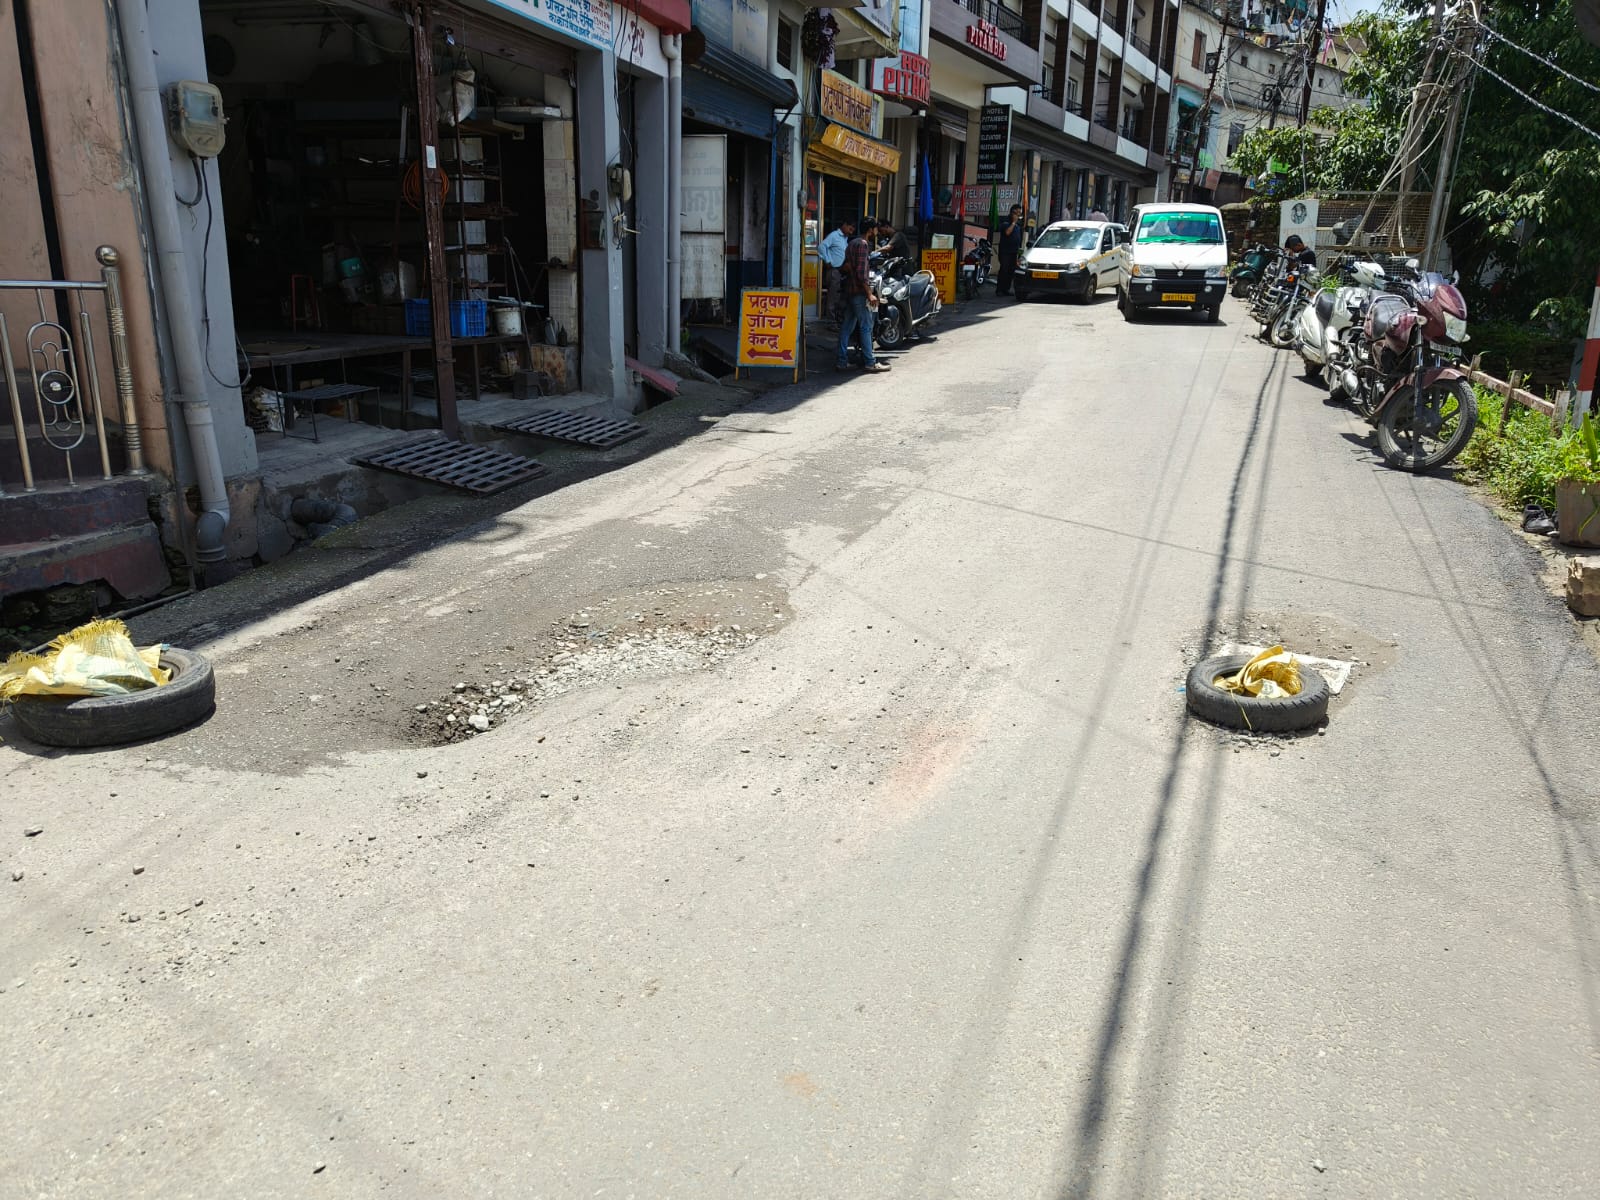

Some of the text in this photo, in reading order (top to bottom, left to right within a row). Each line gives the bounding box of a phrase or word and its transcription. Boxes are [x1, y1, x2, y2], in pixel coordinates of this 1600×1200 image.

[978, 18, 998, 37] HOTEL
[967, 25, 1007, 60] PITAMBER
[955, 189, 1014, 199] HTEL PITBER
[747, 295, 789, 312] प्रदूषण
